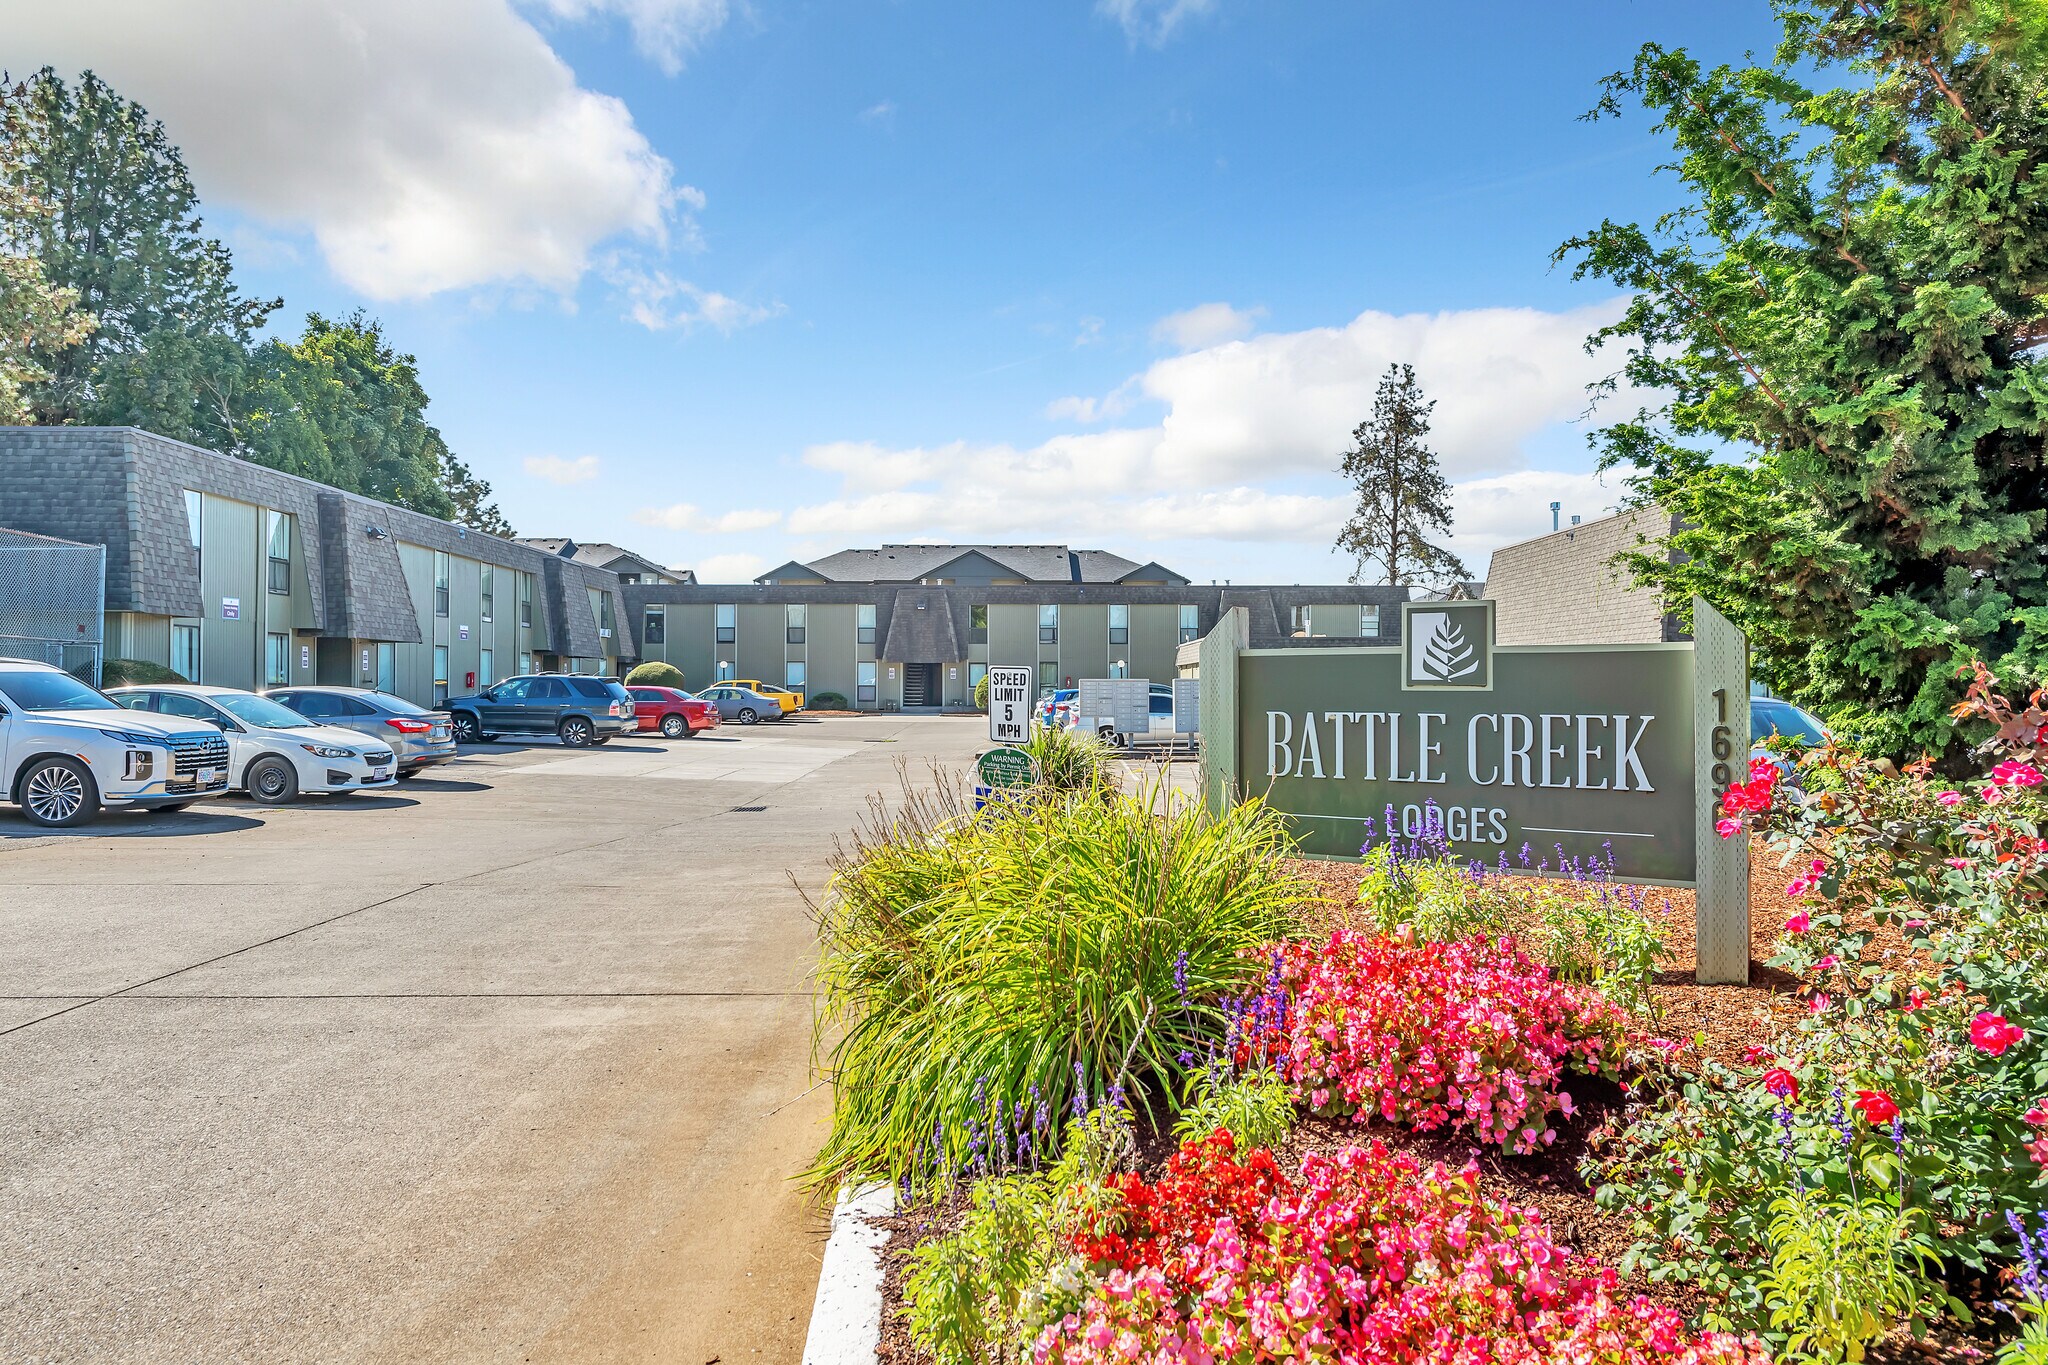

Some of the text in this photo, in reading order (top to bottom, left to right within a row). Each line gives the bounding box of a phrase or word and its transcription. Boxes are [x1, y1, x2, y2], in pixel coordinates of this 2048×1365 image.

[993, 672, 1026, 686] SPEED
[994, 688, 1024, 701] LIMIT
[1004, 704, 1013, 721] 5
[997, 724, 1021, 738] MPH
[1266, 711, 1656, 792] BATTLE CREEK
[991, 754, 1025, 765] WARNING
